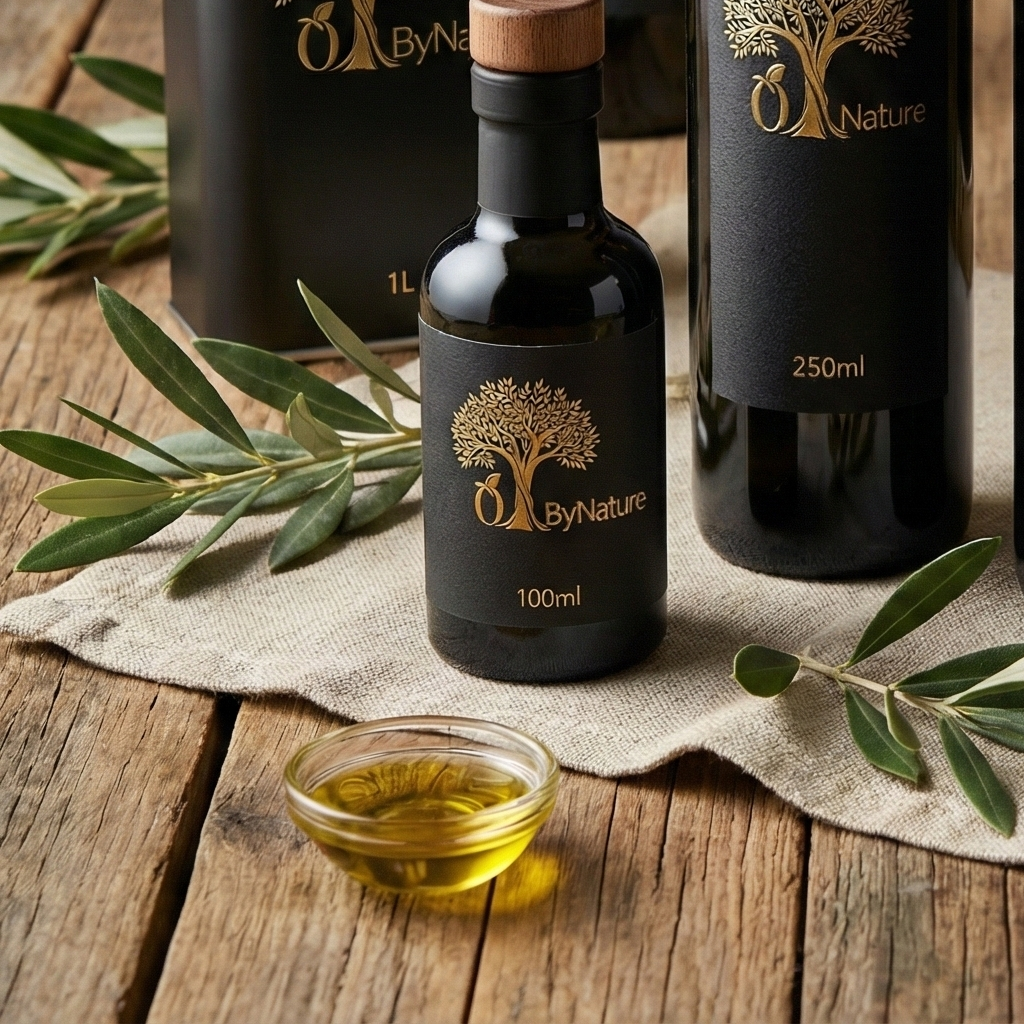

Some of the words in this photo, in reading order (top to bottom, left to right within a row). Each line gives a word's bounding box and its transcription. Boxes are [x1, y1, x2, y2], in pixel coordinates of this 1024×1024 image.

[392, 20, 469, 66] ByNa
[840, 99, 926, 132] Nature
[388, 270, 415, 295] 1L
[792, 354, 865, 380] 250ml
[544, 489, 648, 532] ByNature
[516, 585, 582, 609] 100ml
